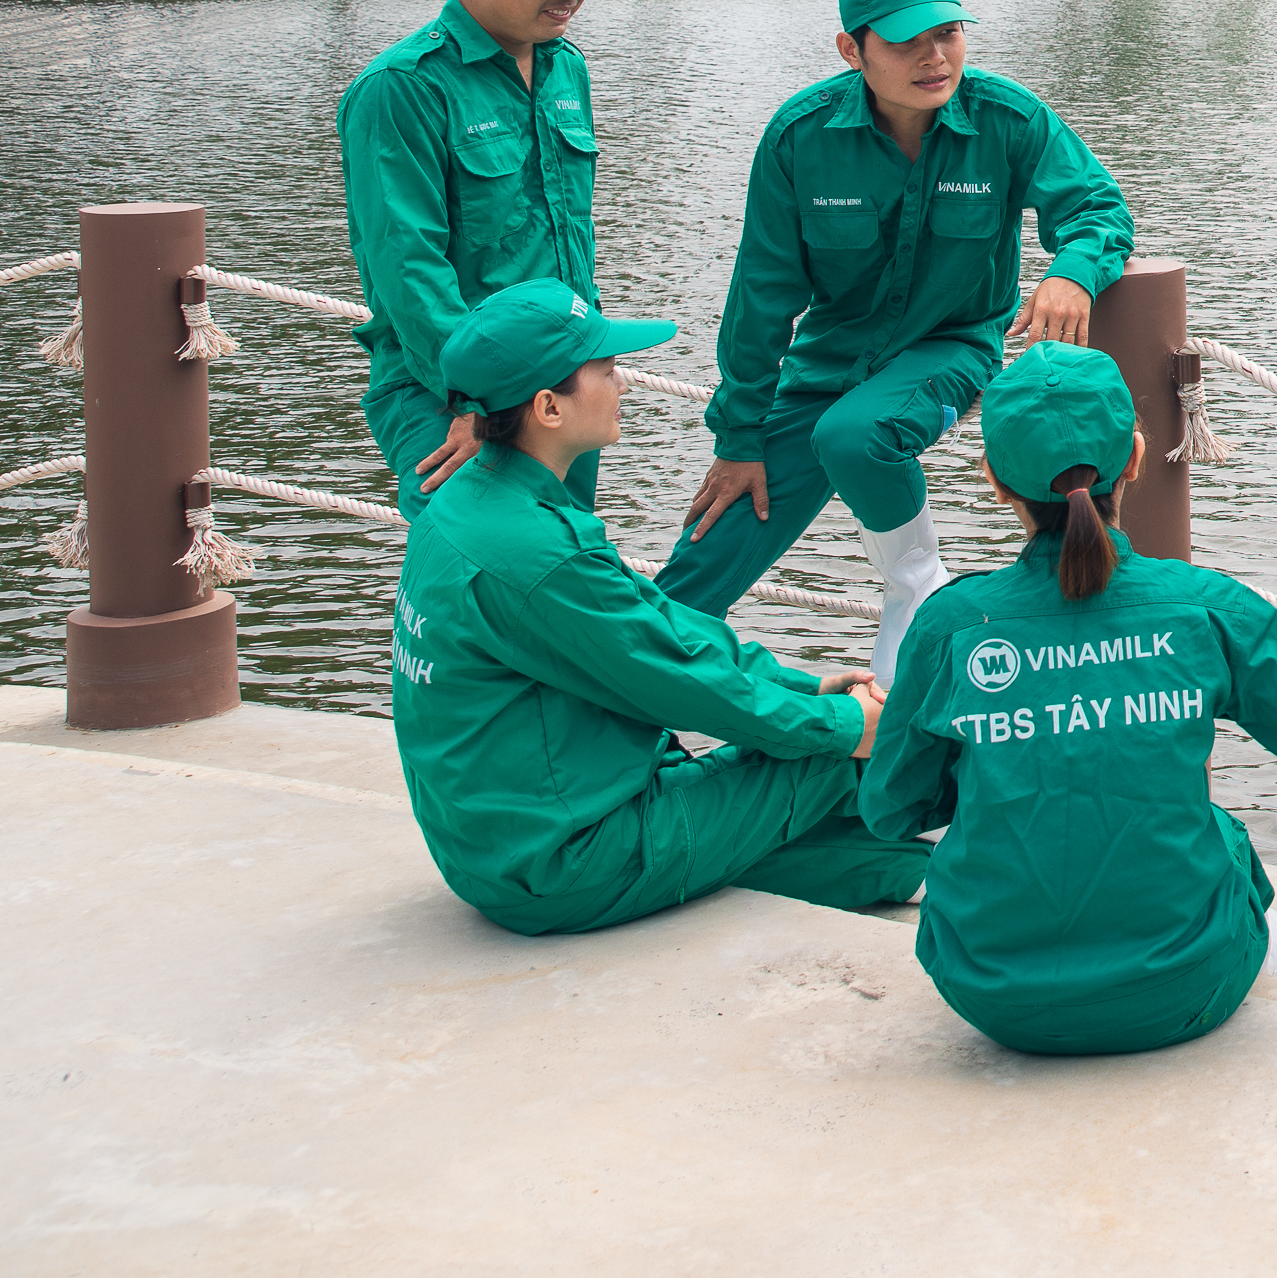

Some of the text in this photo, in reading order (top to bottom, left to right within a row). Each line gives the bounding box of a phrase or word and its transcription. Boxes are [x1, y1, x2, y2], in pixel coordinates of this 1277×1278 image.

[938, 181, 992, 194] VINAMILK
[1024, 631, 1175, 672] VINAMILK
[1045, 693, 1112, 734] TÂY
[1124, 688, 1203, 725] NINH
